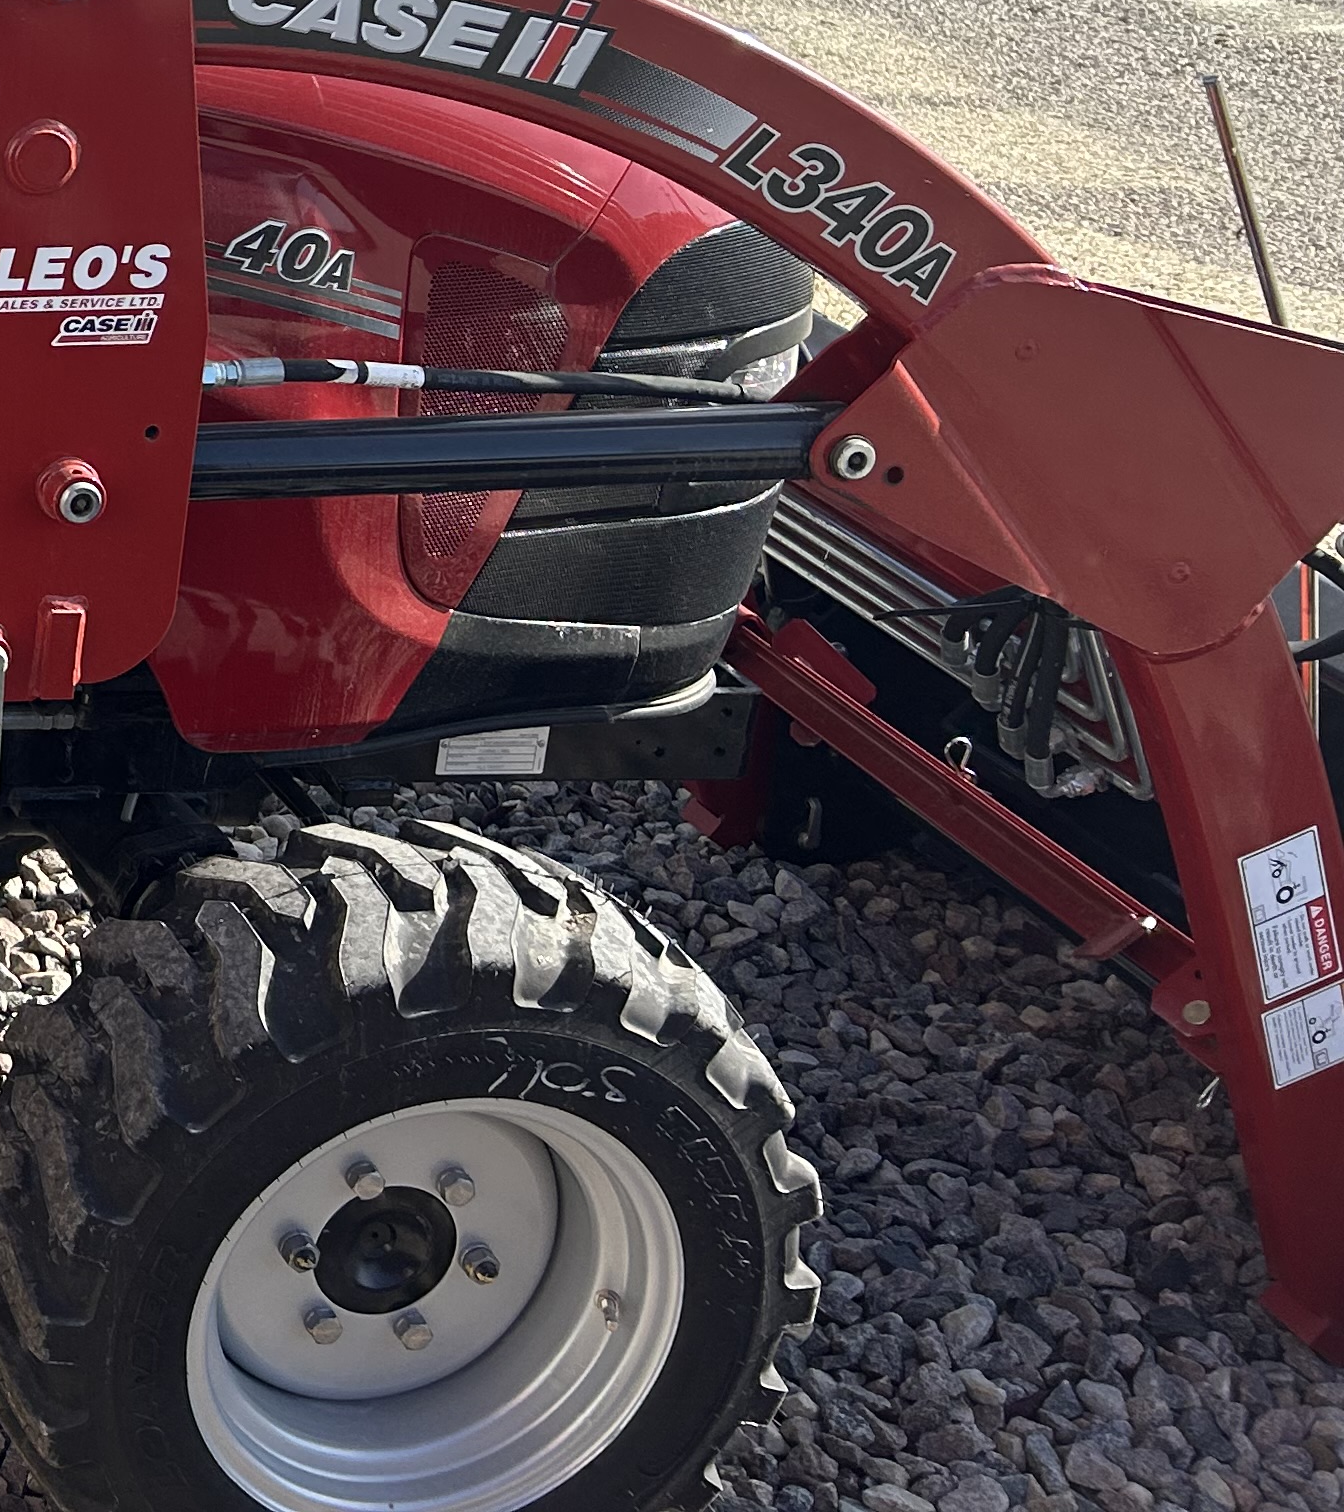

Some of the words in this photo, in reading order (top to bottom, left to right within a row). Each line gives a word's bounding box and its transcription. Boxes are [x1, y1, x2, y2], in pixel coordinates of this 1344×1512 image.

[719, 122, 958, 307] L340A
[223, 218, 355, 293] 40A
[43, 299, 54, 309] &
[59, 297, 126, 309] SERVICE
[128, 296, 161, 307] LTD.
[63, 317, 131, 333] CASE
[1314, 918, 1333, 971] DANGER
